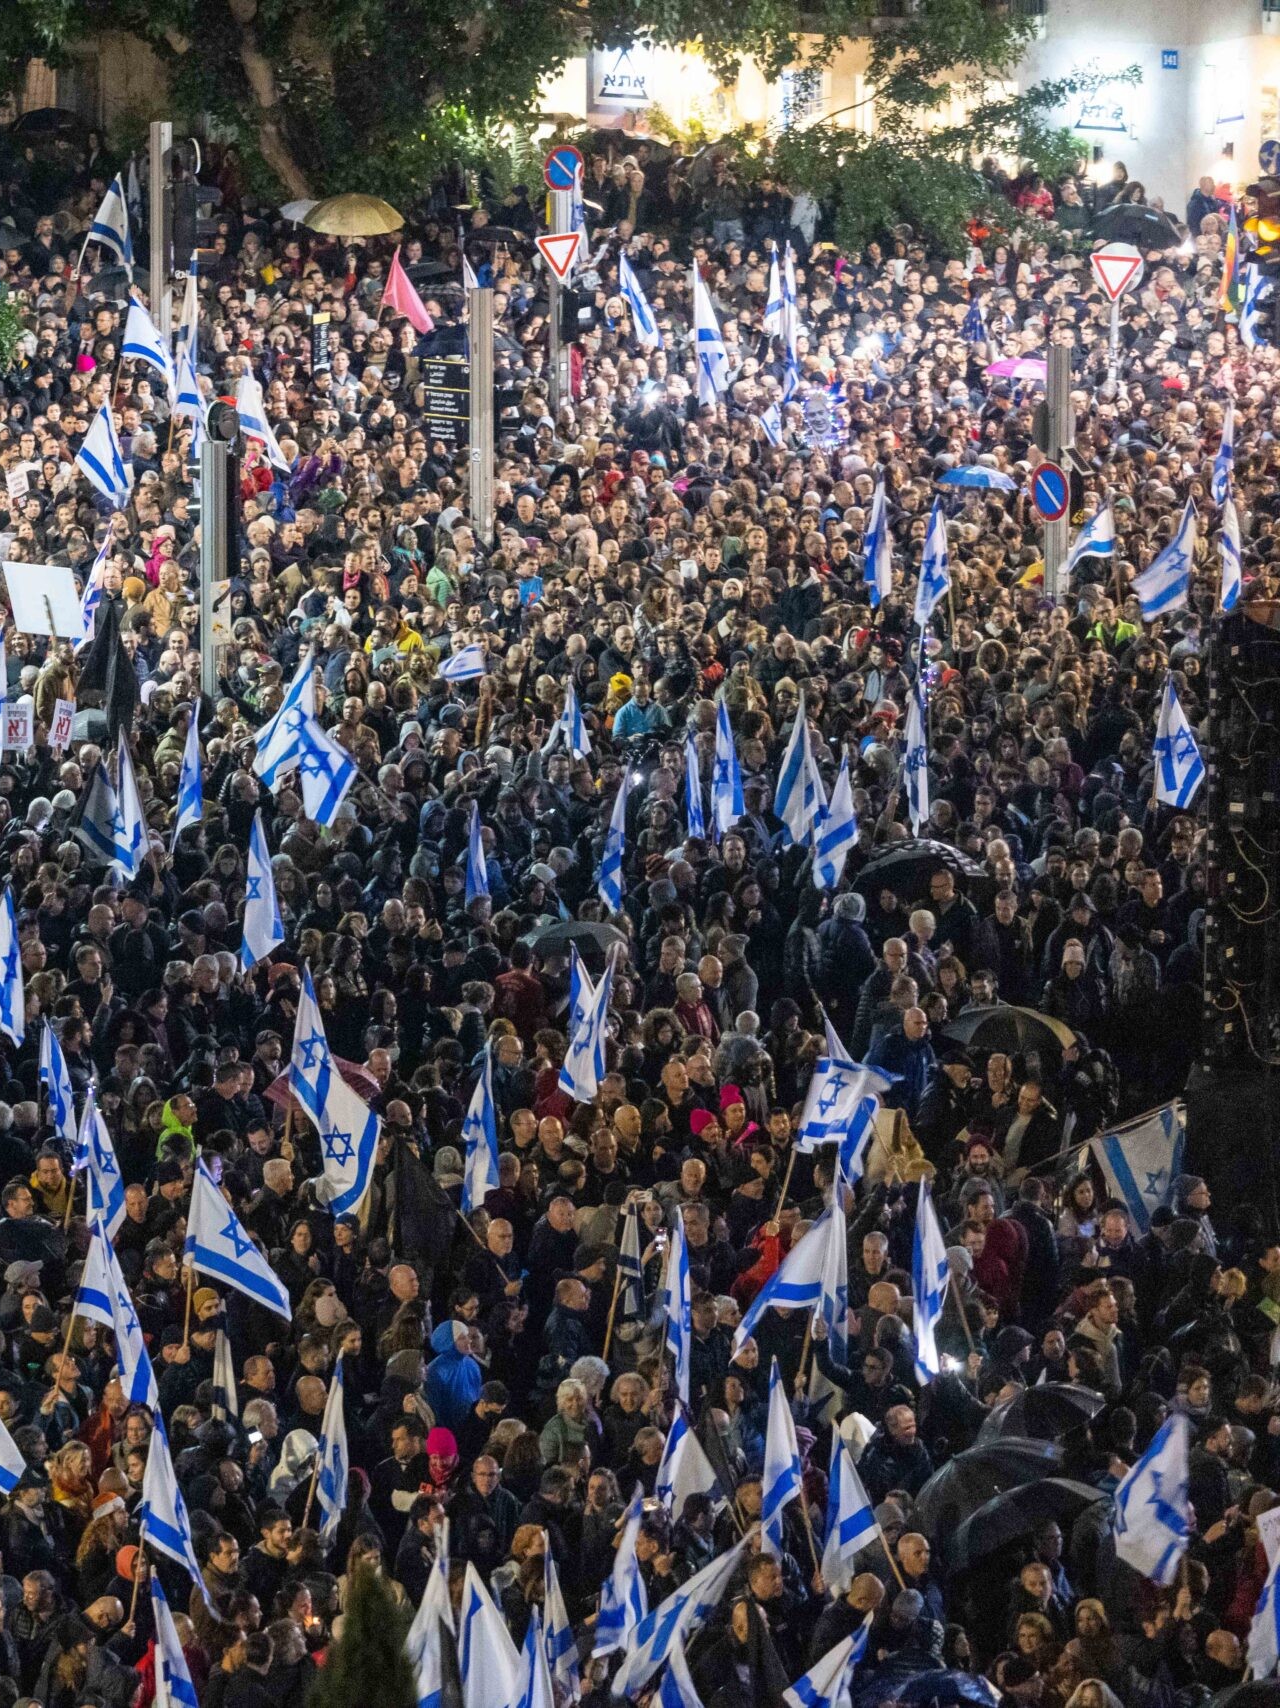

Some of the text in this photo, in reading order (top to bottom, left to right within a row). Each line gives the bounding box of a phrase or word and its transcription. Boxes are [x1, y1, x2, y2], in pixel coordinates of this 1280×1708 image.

[603, 74, 645, 88] אתא
[7, 717, 27, 736] לא
[55, 716, 71, 736] לא
